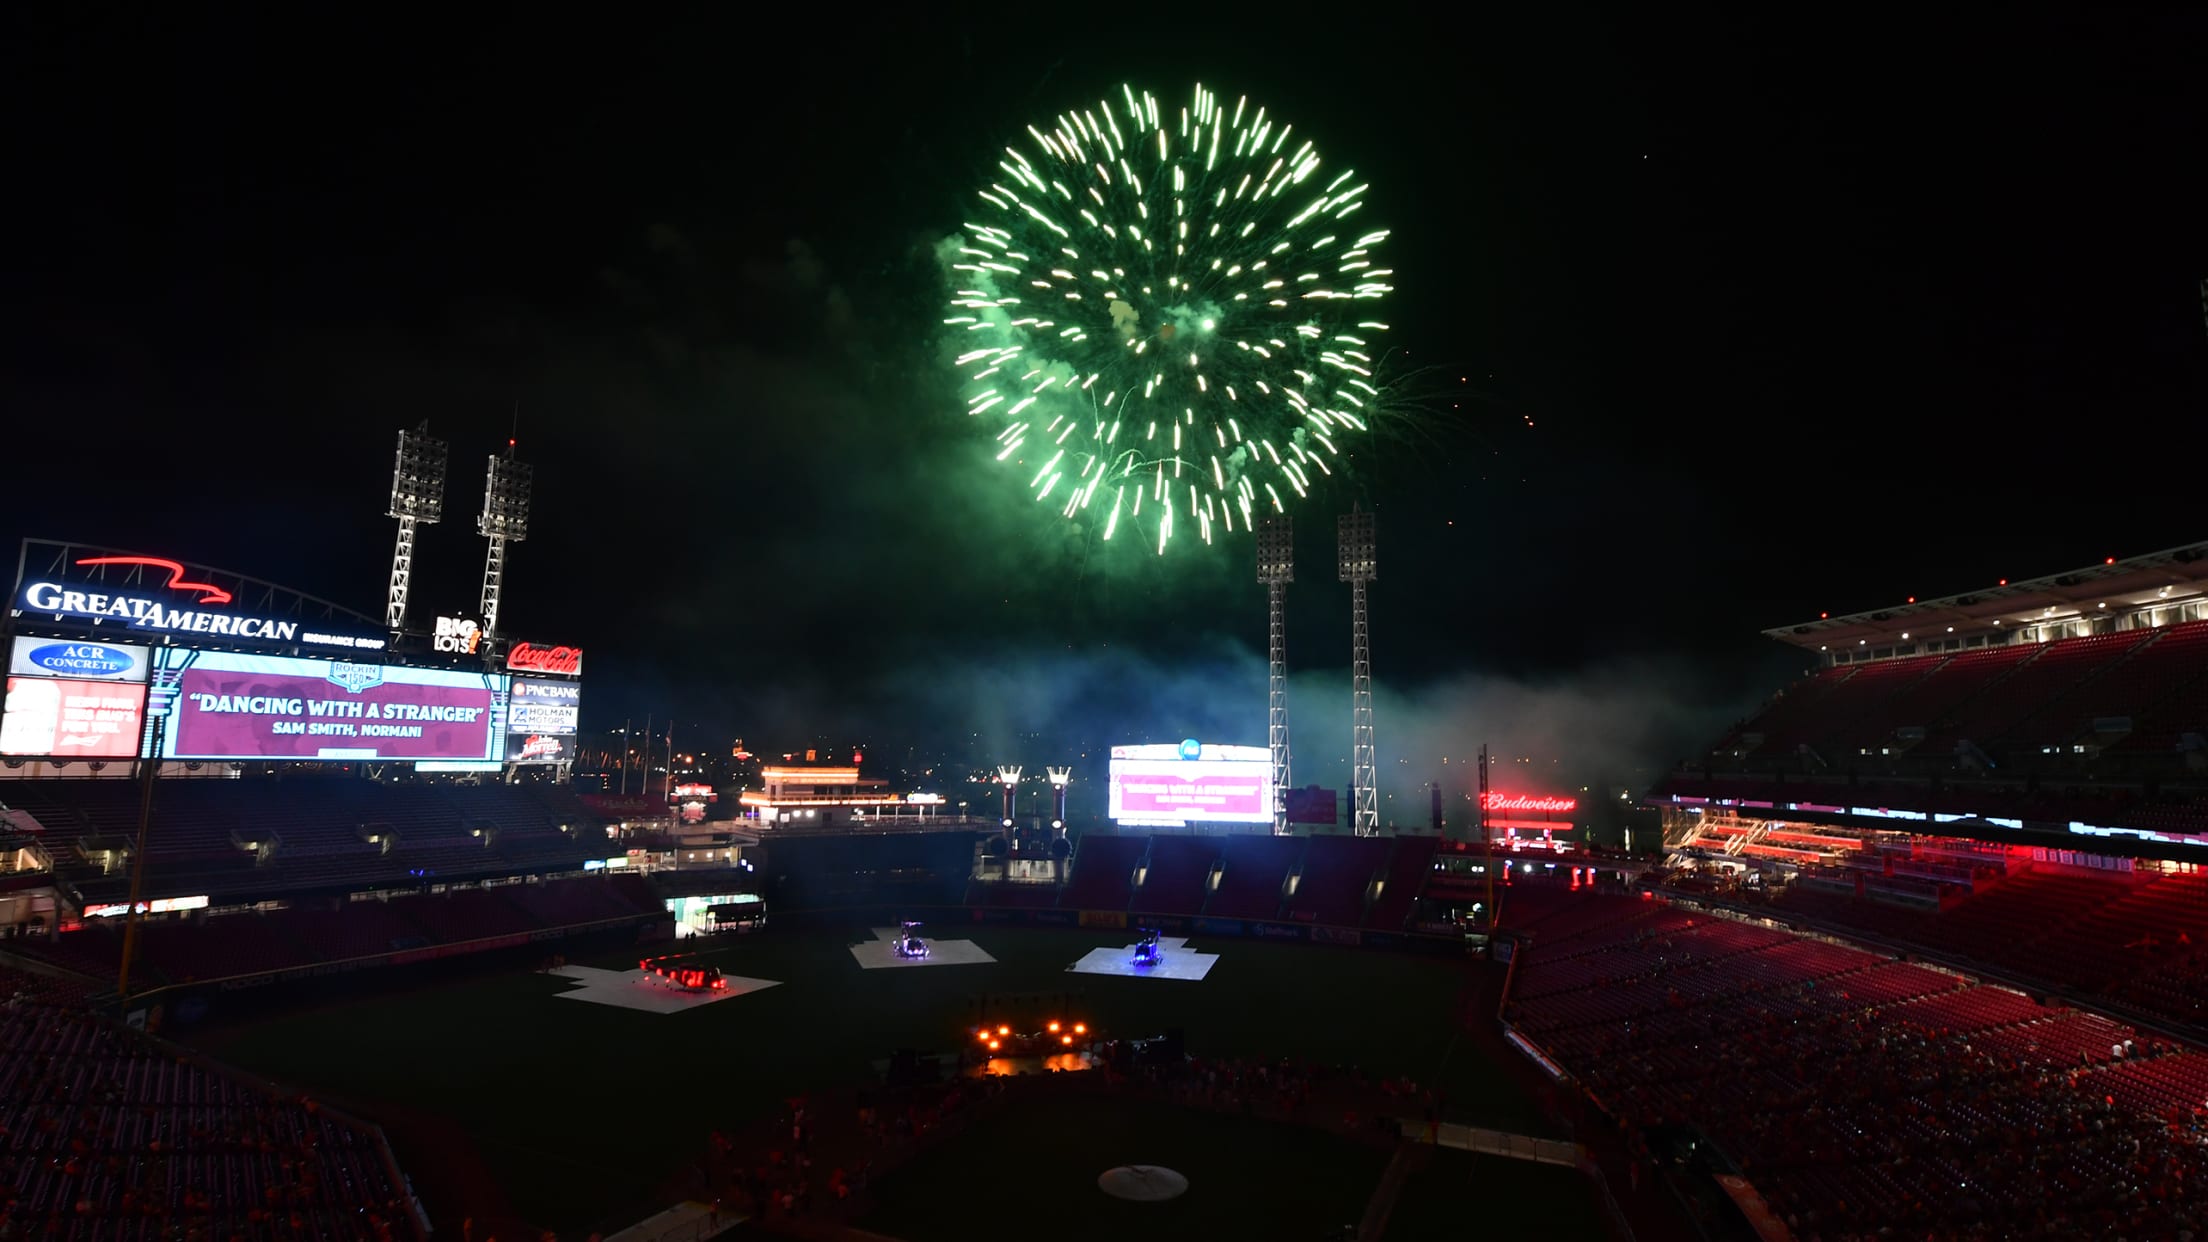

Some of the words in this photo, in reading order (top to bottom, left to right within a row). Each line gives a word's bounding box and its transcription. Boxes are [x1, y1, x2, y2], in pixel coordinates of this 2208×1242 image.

[26, 582, 151, 620] GREAT
[135, 602, 298, 641] AMERICAN
[435, 616, 478, 639] BIG
[63, 646, 104, 659] ACR
[43, 657, 118, 671] CONCRETE
[307, 700, 363, 718] WITH
[365, 703, 380, 719] A
[529, 708, 572, 717] HOLMAN
[528, 716, 565, 725] MOTORS
[272, 721, 306, 735] SAM
[308, 724, 358, 738] SMITH,
[361, 725, 422, 738] NORMANI
[1481, 794, 1576, 811] Budweiser
